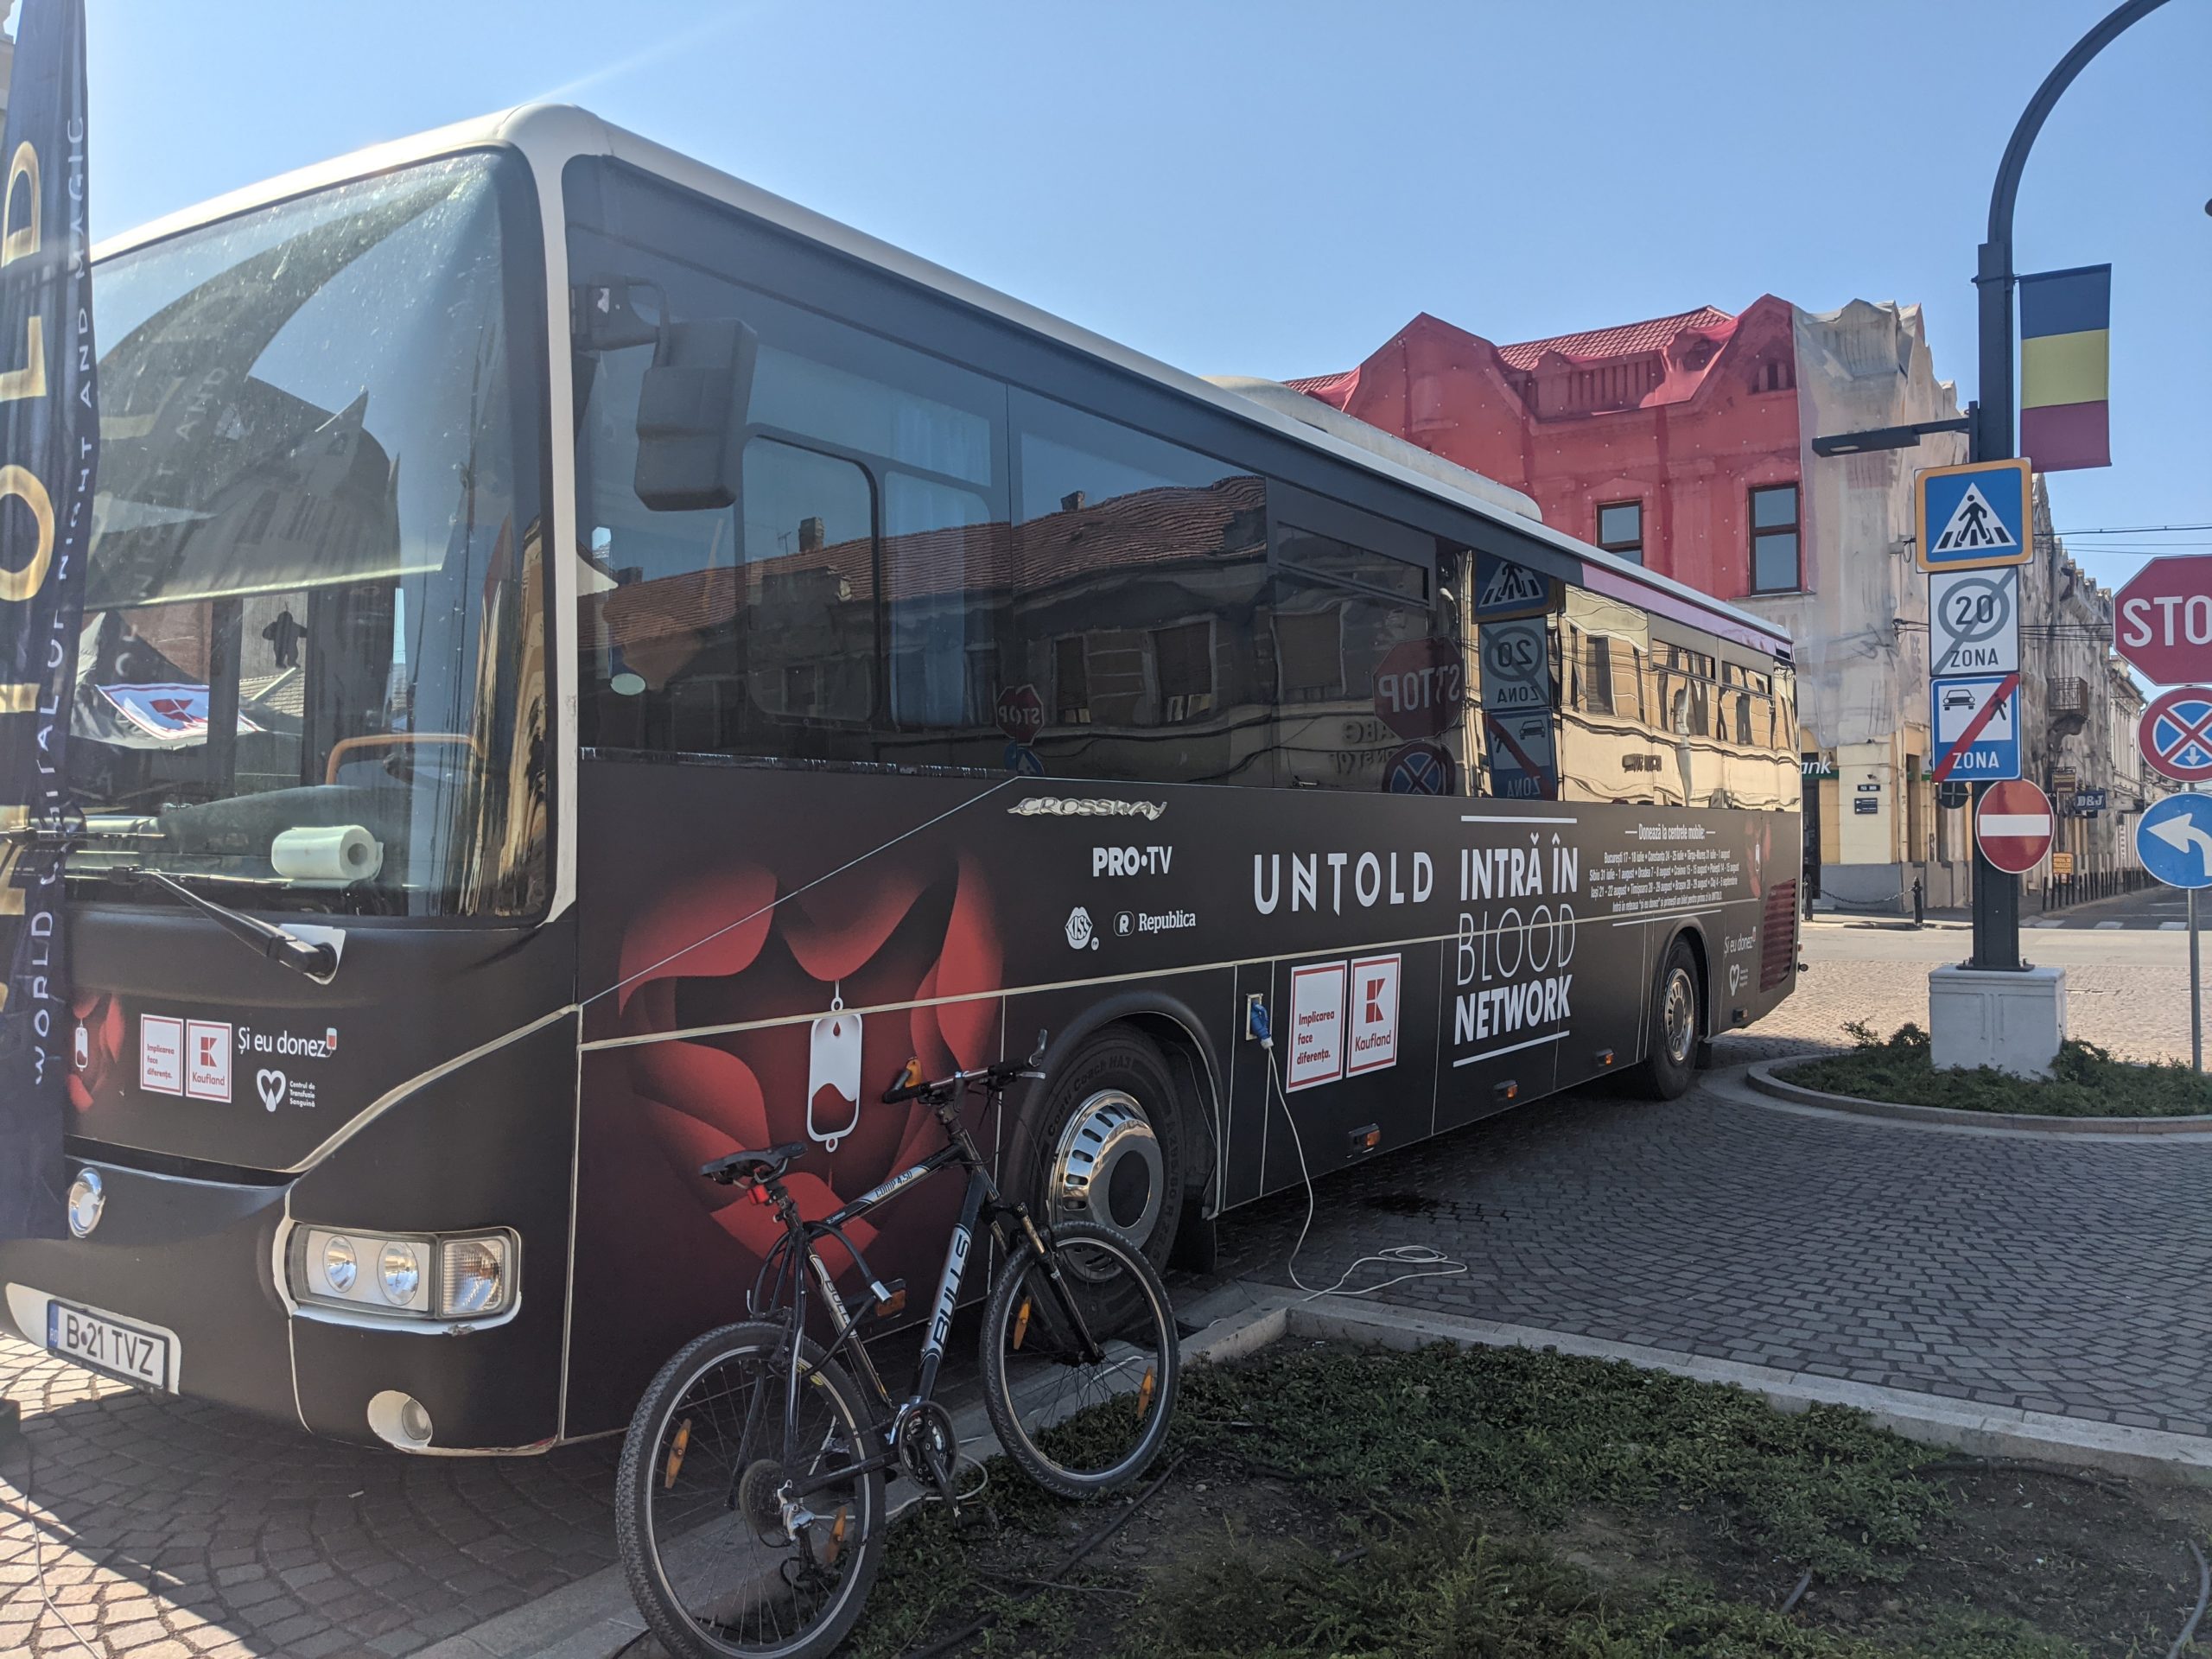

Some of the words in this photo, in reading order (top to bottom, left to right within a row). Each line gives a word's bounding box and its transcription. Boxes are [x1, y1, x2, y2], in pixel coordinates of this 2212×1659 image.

[1955, 594, 1994, 626] 20
[2122, 594, 2212, 648] STO
[1950, 648, 1999, 668] ZONA
[31, 911, 57, 1086] WORLD
[79, 308, 92, 410] AND
[1802, 756, 1832, 774] ank
[1952, 752, 1999, 769] ZONA
[1007, 797, 1167, 821] CROSSWAY
[2076, 795, 2104, 807] D&J
[1460, 832, 1543, 901] INTRĂ
[1552, 832, 1578, 894] ÎN
[1254, 851, 1433, 917] UNTOLD
[1138, 910, 1196, 934] Republica
[1457, 903, 1576, 986] BLOOD
[1299, 1010, 1335, 1027] Implicarea
[1454, 974, 1573, 1046] NETWORK
[147, 1043, 175, 1055] Implicarea
[238, 1027, 250, 1054] Și
[254, 1035, 272, 1052] eu
[276, 1031, 327, 1058] donez
[1297, 1033, 1313, 1046] face
[1355, 1029, 1391, 1052] Kaufland
[147, 1055, 158, 1065] face
[192, 1071, 226, 1086] Kaufland
[874, 1181, 897, 1198] COMP
[933, 1235, 972, 1346] BULLS
[824, 1278, 854, 1333] BULL
[49, 1328, 59, 1343] RO
[67, 1313, 79, 1351] B
[86, 1322, 104, 1360] 21
[111, 1329, 154, 1376] TVZ
